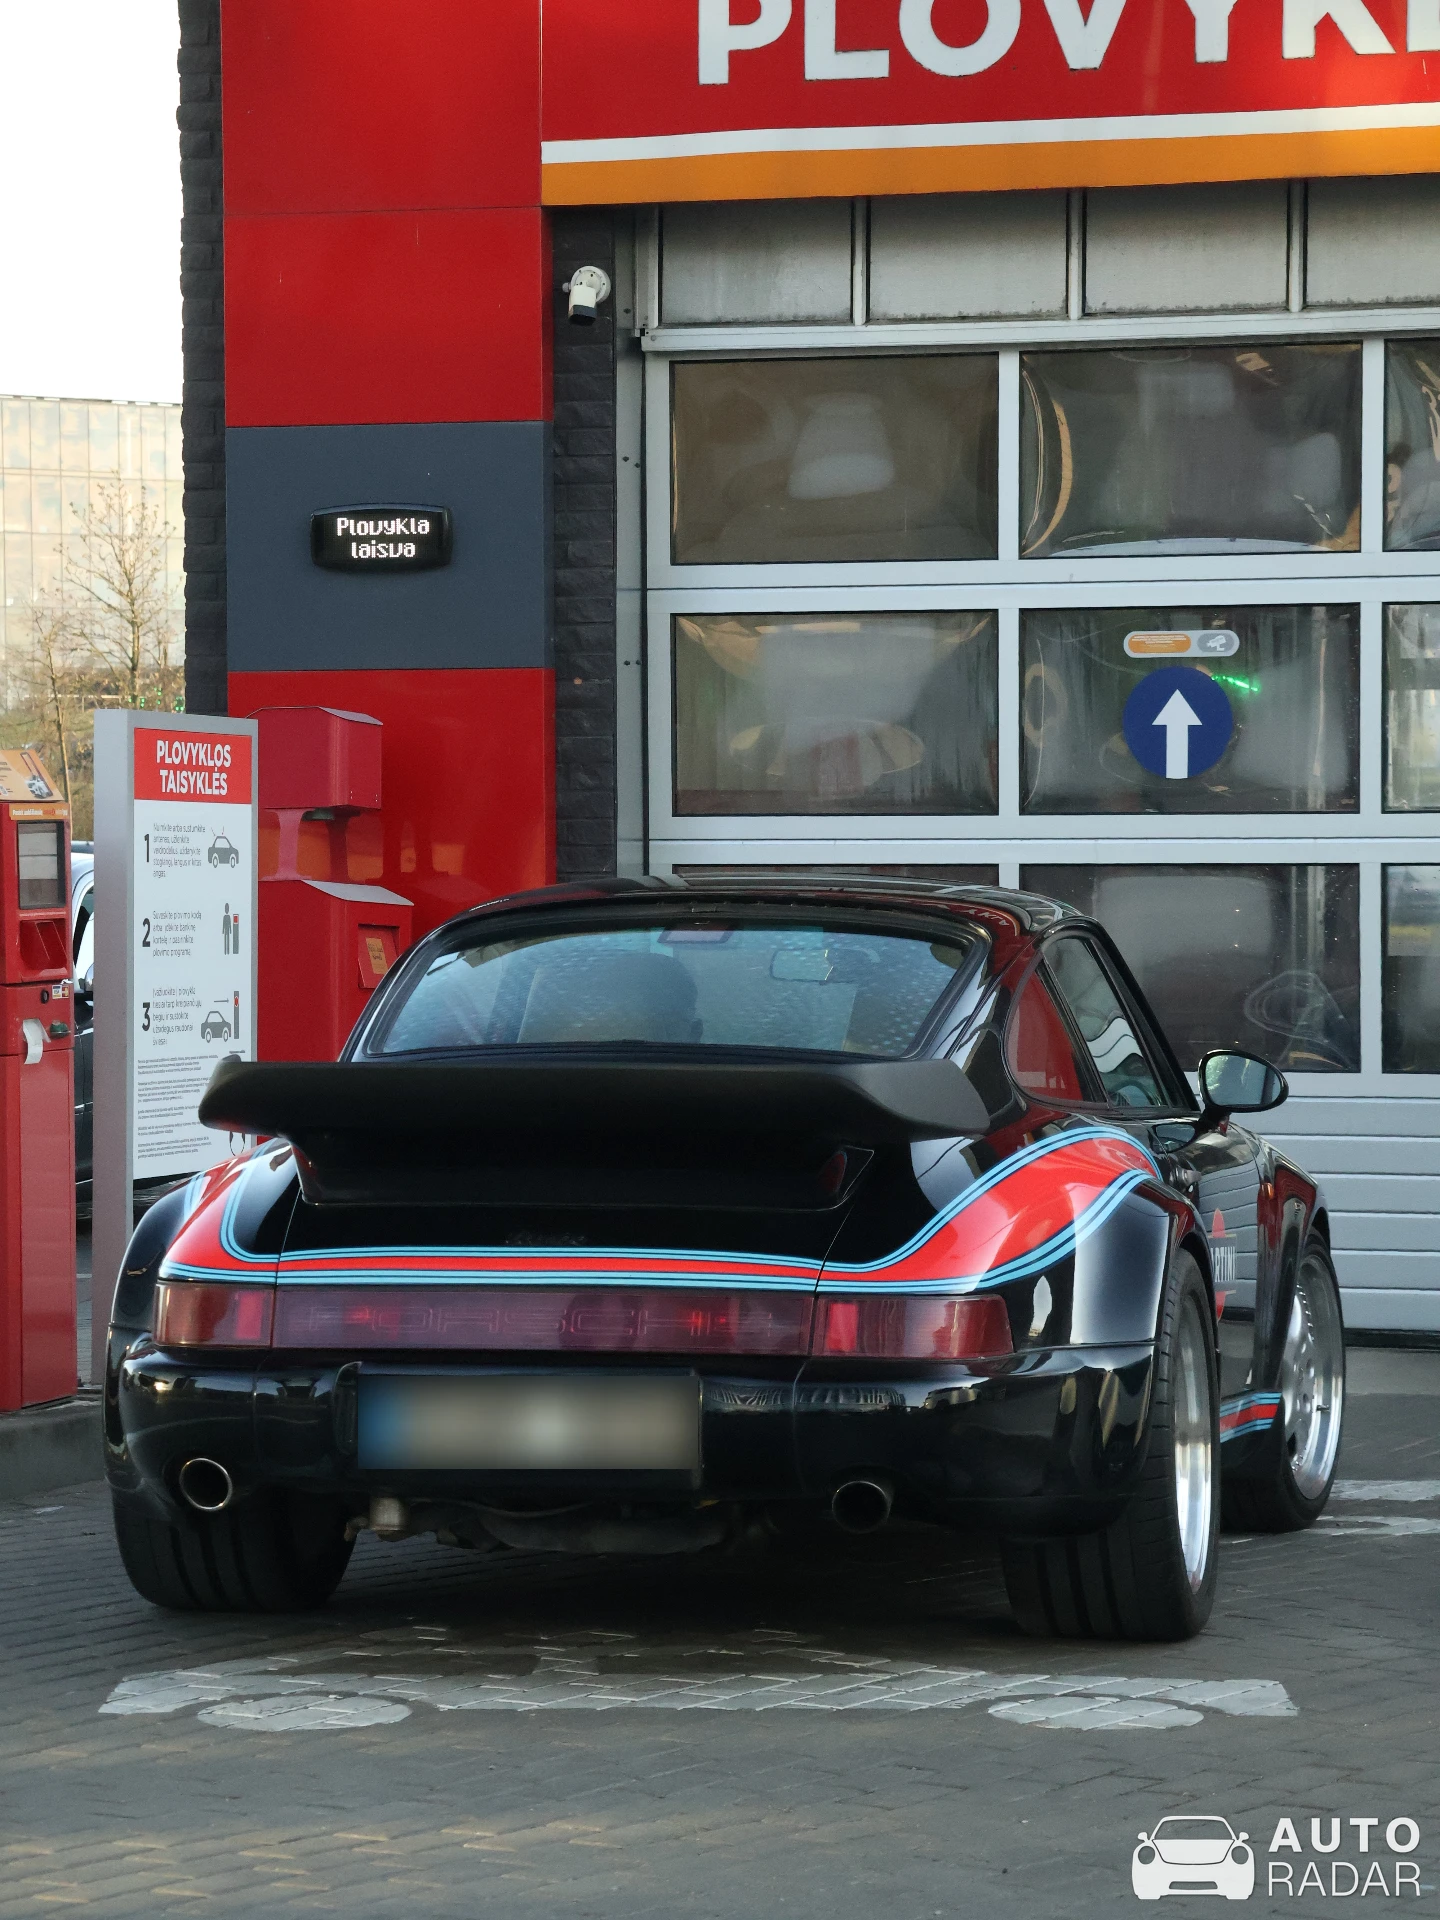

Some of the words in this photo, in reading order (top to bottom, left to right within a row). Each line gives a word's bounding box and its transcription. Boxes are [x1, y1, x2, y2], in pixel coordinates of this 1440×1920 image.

[352, 540, 416, 558] laisva
[156, 740, 232, 768] PLOVYKLOS
[160, 767, 228, 796] TAISYKLĖS
[144, 834, 150, 863] 1
[142, 918, 151, 947] 2
[142, 1002, 150, 1031] 3
